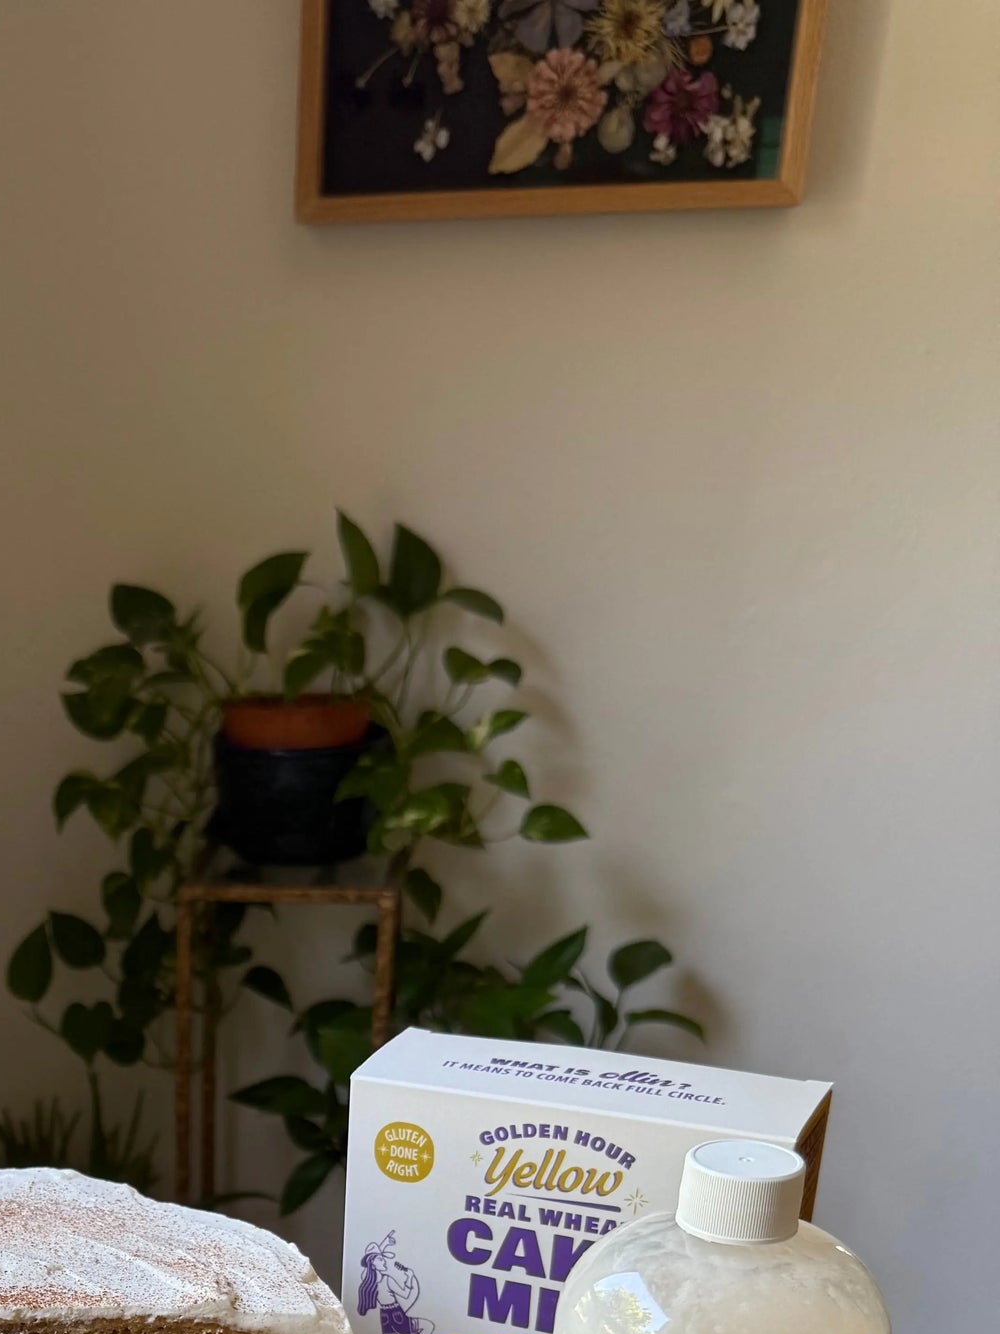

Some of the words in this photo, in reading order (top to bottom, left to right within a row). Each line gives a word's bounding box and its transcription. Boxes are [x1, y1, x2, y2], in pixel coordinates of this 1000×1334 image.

[442, 1060, 455, 1068] IT
[458, 1062, 511, 1076] MEANS
[514, 1068, 533, 1078] TO
[536, 1072, 578, 1085] COME
[582, 1078, 621, 1091] BACK
[625, 1084, 663, 1097] FULL
[667, 1090, 727, 1106] CIRCLE.
[490, 1057, 560, 1073] WHAT
[564, 1067, 590, 1077] IS
[384, 1128, 428, 1148] GLUTEN
[389, 1145, 418, 1161] DONE
[479, 1123, 569, 1146] GOLDEN
[573, 1129, 637, 1171] HOUR
[386, 1159, 420, 1178] RIGHT
[483, 1146, 624, 1197] Yellow
[464, 1195, 532, 1223] REAL
[538, 1207, 621, 1236] WHEA
[446, 1218, 596, 1283] CAK
[467, 1273, 560, 1334] MI
